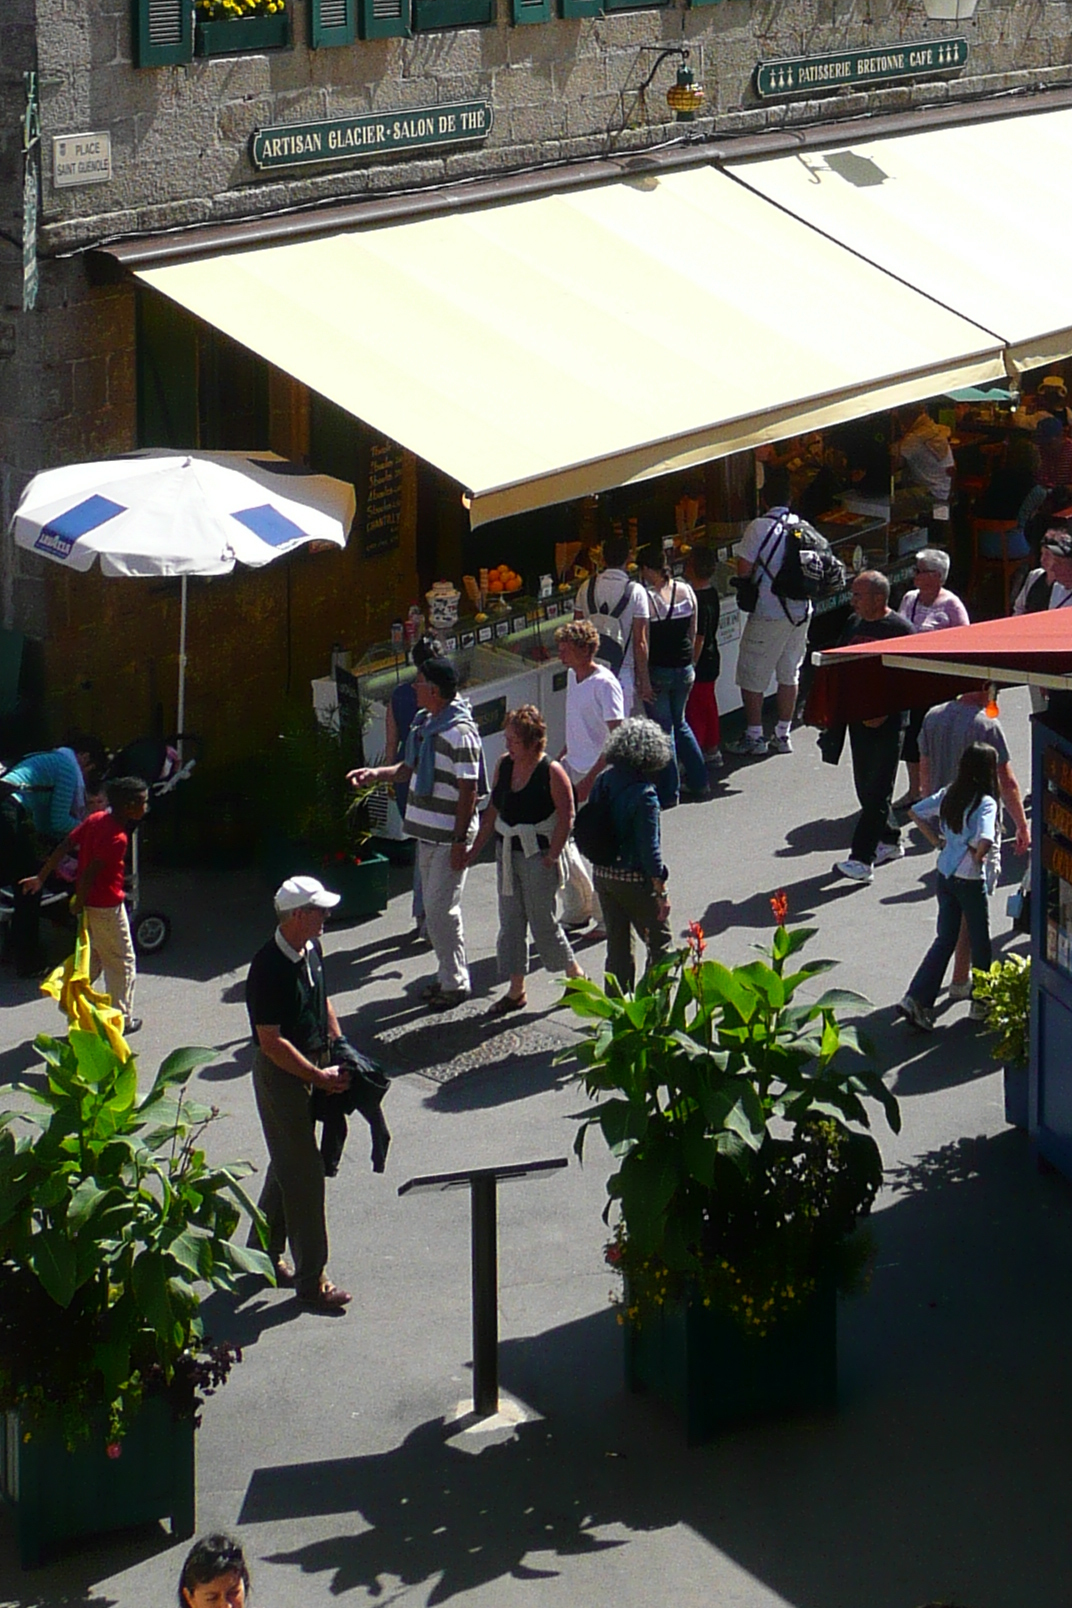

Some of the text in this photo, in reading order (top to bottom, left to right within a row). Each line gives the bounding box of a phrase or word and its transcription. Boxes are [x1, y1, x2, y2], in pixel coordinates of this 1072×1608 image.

[799, 49, 933, 83] PATISSERIE BRETONNE CAFÉ
[262, 108, 485, 158] ARTISAN GLACIER SALON DE THÉ
[76, 141, 100, 156] PLACE
[58, 162, 76, 176] SAINT
